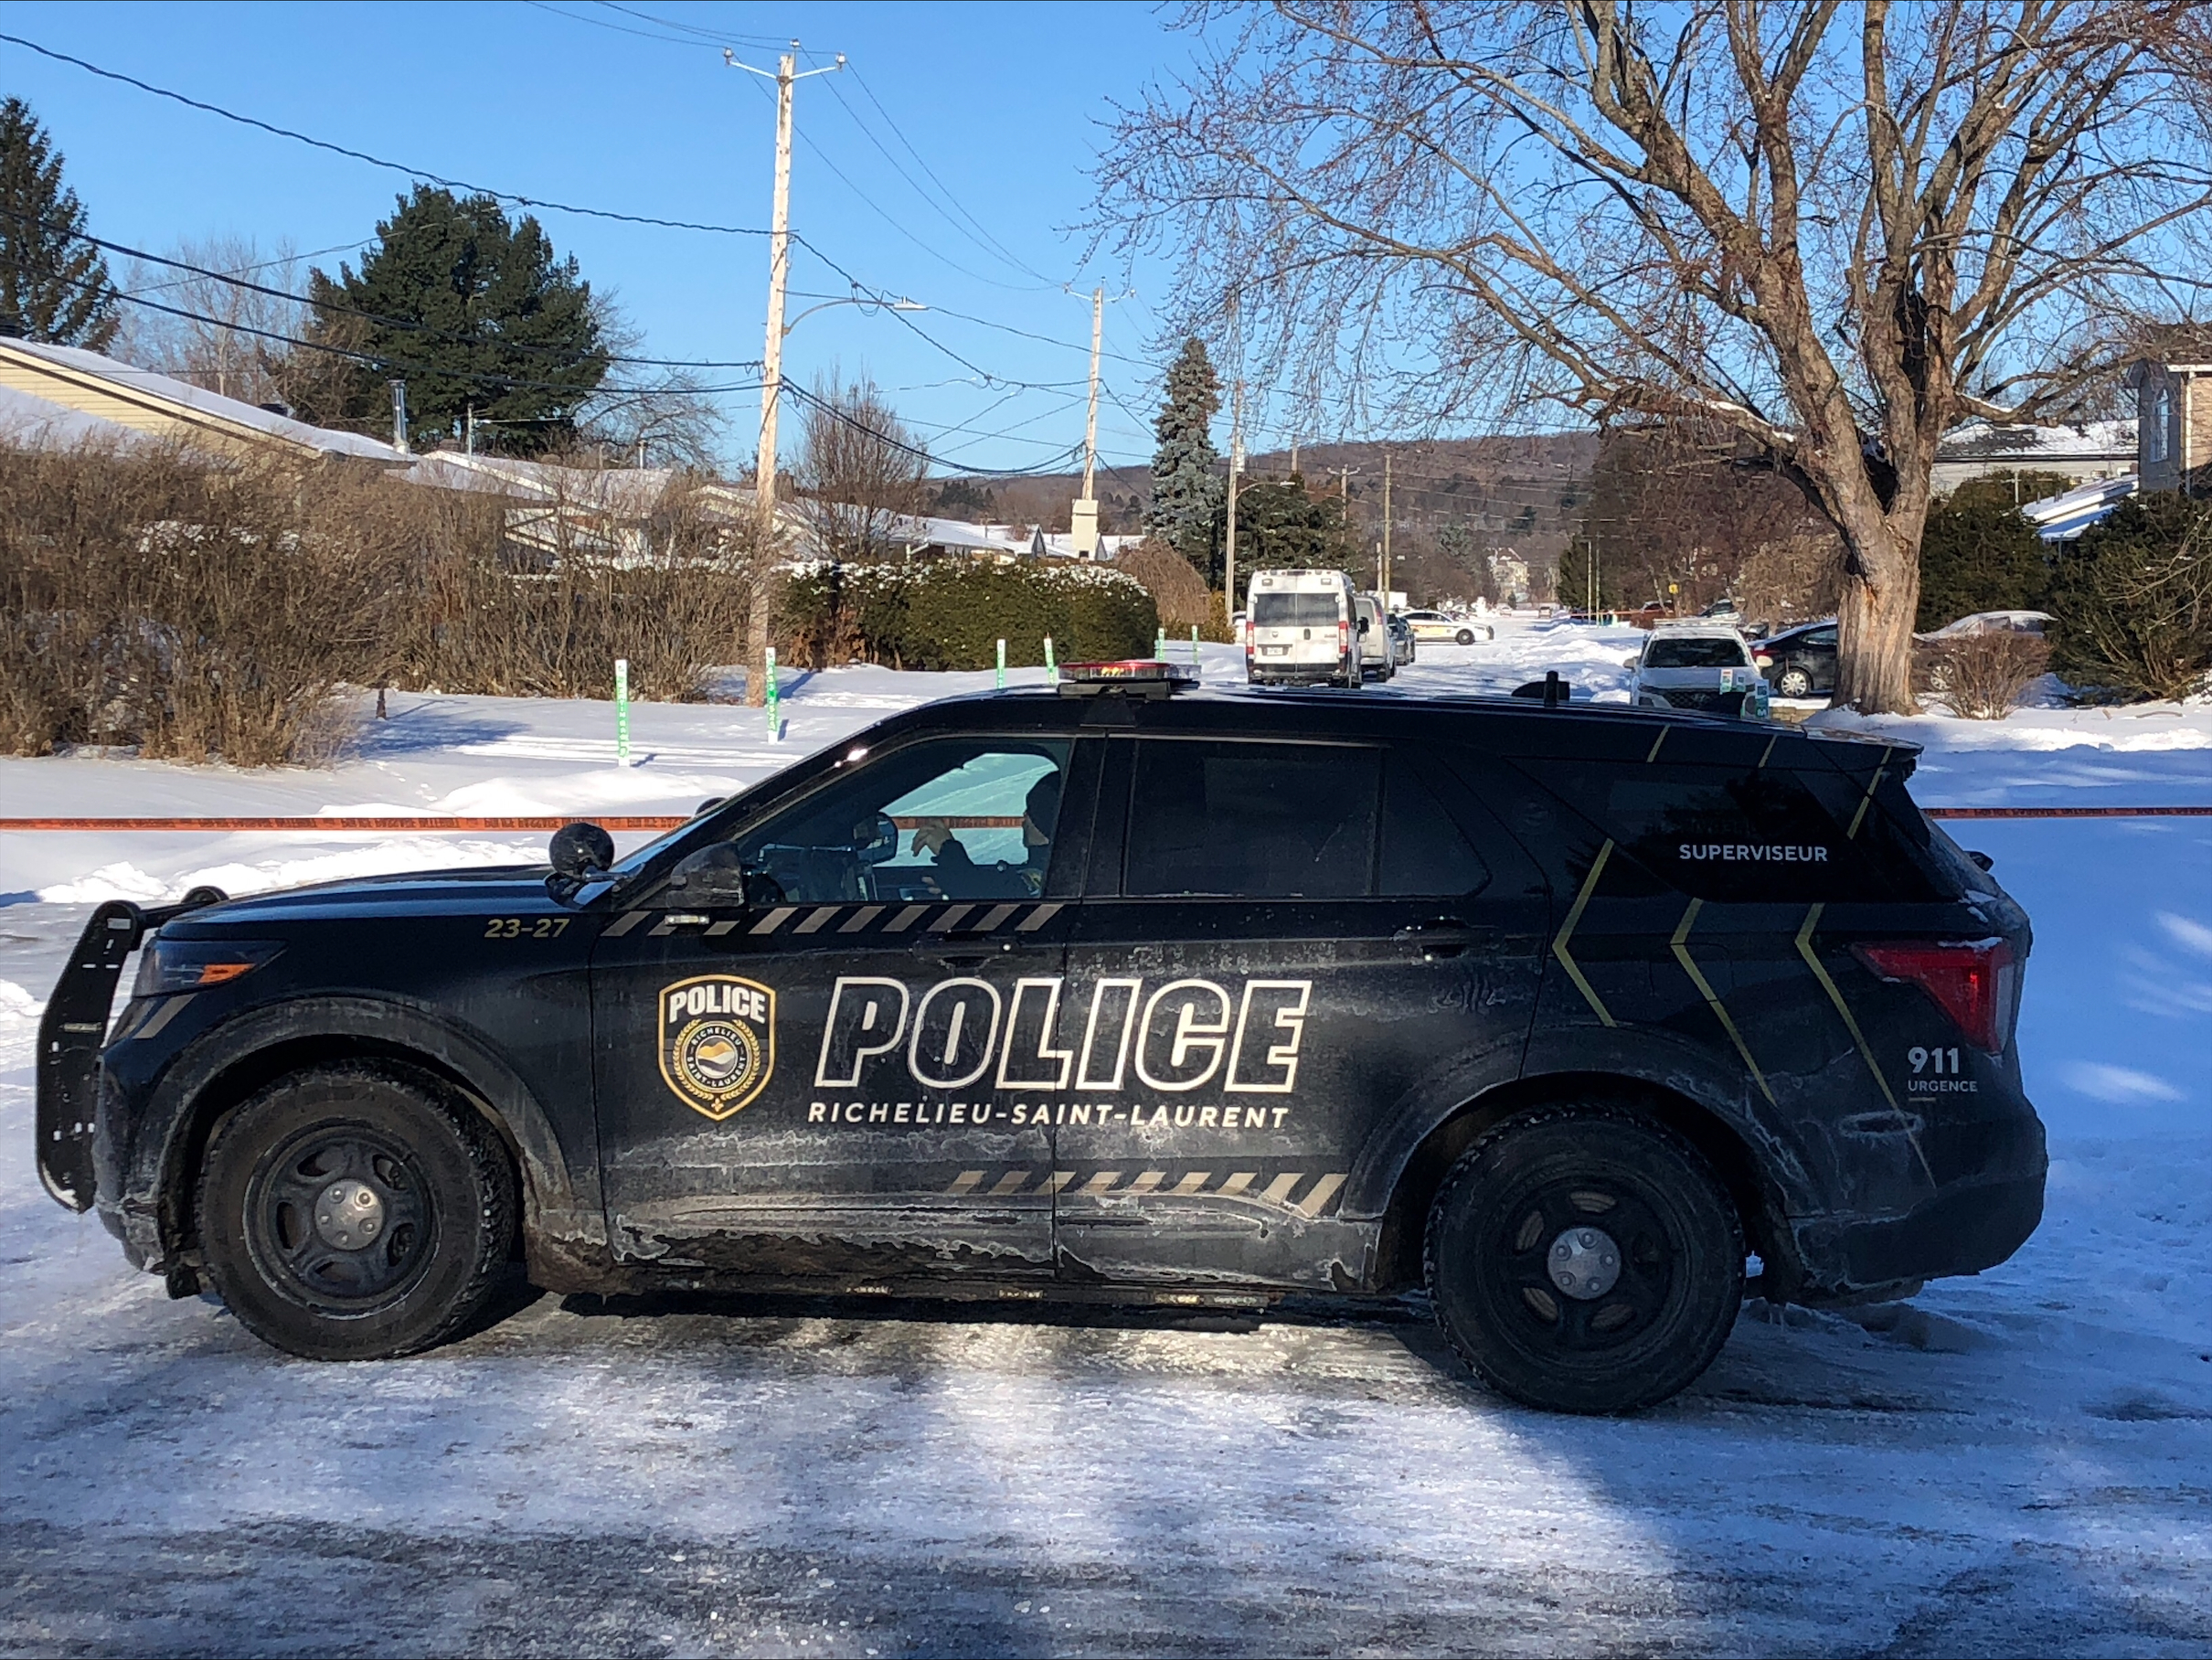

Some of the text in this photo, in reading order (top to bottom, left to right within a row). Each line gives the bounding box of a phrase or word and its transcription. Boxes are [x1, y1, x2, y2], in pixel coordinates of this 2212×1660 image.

[1678, 844, 1828, 862] SUPERVISEUR
[484, 918, 570, 938] 23-27
[669, 984, 766, 1024] POLICE
[691, 1027, 742, 1047] RICHELIEU
[814, 976, 1313, 1094] POLICE
[686, 1056, 747, 1088] SAINT-LAURENT
[1907, 1047, 1960, 1074] 911
[1907, 1080, 1978, 1093] URGENCE
[808, 1101, 1290, 1129] RICHELIEU-SAINT-LAURENT
